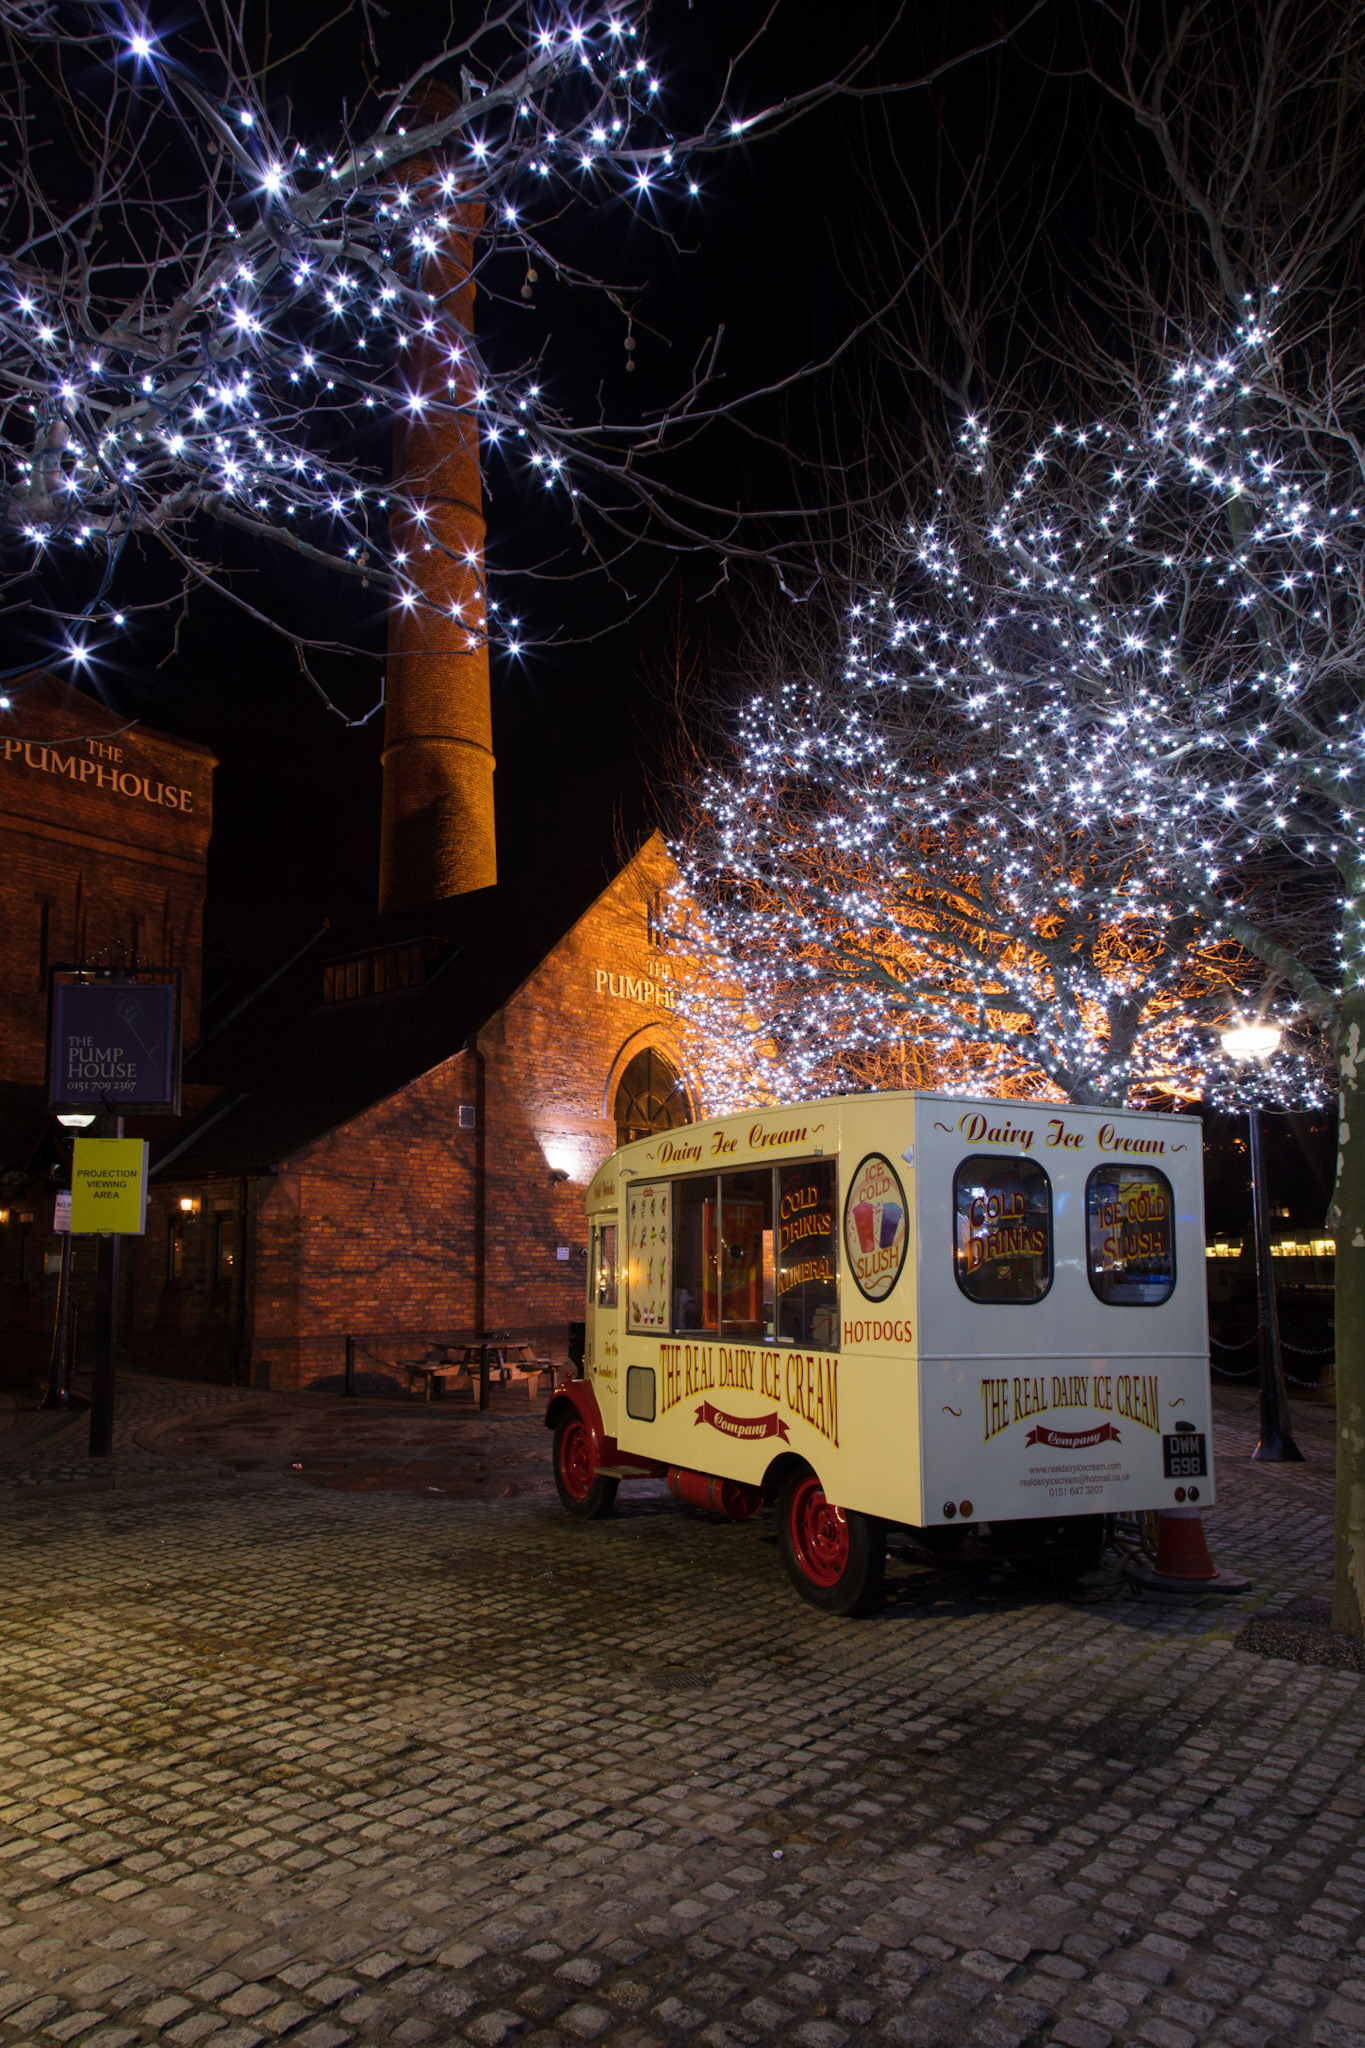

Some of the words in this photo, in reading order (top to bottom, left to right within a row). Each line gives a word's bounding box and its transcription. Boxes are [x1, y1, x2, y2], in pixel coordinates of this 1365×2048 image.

[86, 738, 123, 764] THE
[4, 739, 193, 813] PUMPHOUSE
[67, 1036, 94, 1047] THE
[68, 1048, 124, 1063] PUMP
[67, 1063, 137, 1078] HOUSE
[67, 1081, 88, 1092] 0151
[91, 1081, 111, 1092] 709
[113, 1080, 137, 1092] 2367
[656, 1140, 703, 1166] Dairy
[710, 1131, 738, 1157] Ice
[748, 1122, 808, 1149] Cream
[958, 1112, 1036, 1152] Dairy
[1045, 1119, 1085, 1150] Ice
[1097, 1123, 1166, 1156] Cream
[77, 1169, 137, 1178] PROJECTION
[865, 1161, 885, 1181] ICE
[87, 1180, 127, 1188] VIEWING
[93, 1191, 120, 1199] AREA
[859, 1178, 891, 1203] COLD
[781, 1185, 819, 1220] COLD
[969, 1193, 1026, 1230] COLD
[1098, 1200, 1123, 1231] ICE
[1127, 1196, 1166, 1224] COLD
[778, 1213, 832, 1254] DRINKS
[857, 1246, 900, 1280] SLUSH
[966, 1229, 1045, 1275] DRINKS
[1103, 1231, 1165, 1271] SLUSH
[777, 1258, 834, 1297] MINERAL
[843, 1320, 912, 1345] HOTDOGS
[659, 1344, 682, 1416] THE
[684, 1345, 715, 1399] REAL
[718, 1347, 756, 1391] DAIRY
[760, 1351, 781, 1402] ICE
[785, 1353, 839, 1450] CREAM
[980, 1377, 1010, 1444] THE
[1012, 1376, 1048, 1424] REAL
[1051, 1376, 1089, 1410] DAIRY
[1093, 1376, 1113, 1412] ICE
[1115, 1375, 1161, 1435] CREAM
[713, 1412, 768, 1437] Company
[1047, 1431, 1101, 1448] Company
[1170, 1435, 1200, 1455] DWM
[1028, 1462, 1122, 1475] www.realdairyicecream.com
[1170, 1457, 1200, 1476] 698
[1020, 1472, 1131, 1487] realdairyicecream@hotmail.co.uk
[1049, 1488, 1067, 1497] 0151
[1069, 1486, 1084, 1496] 647
